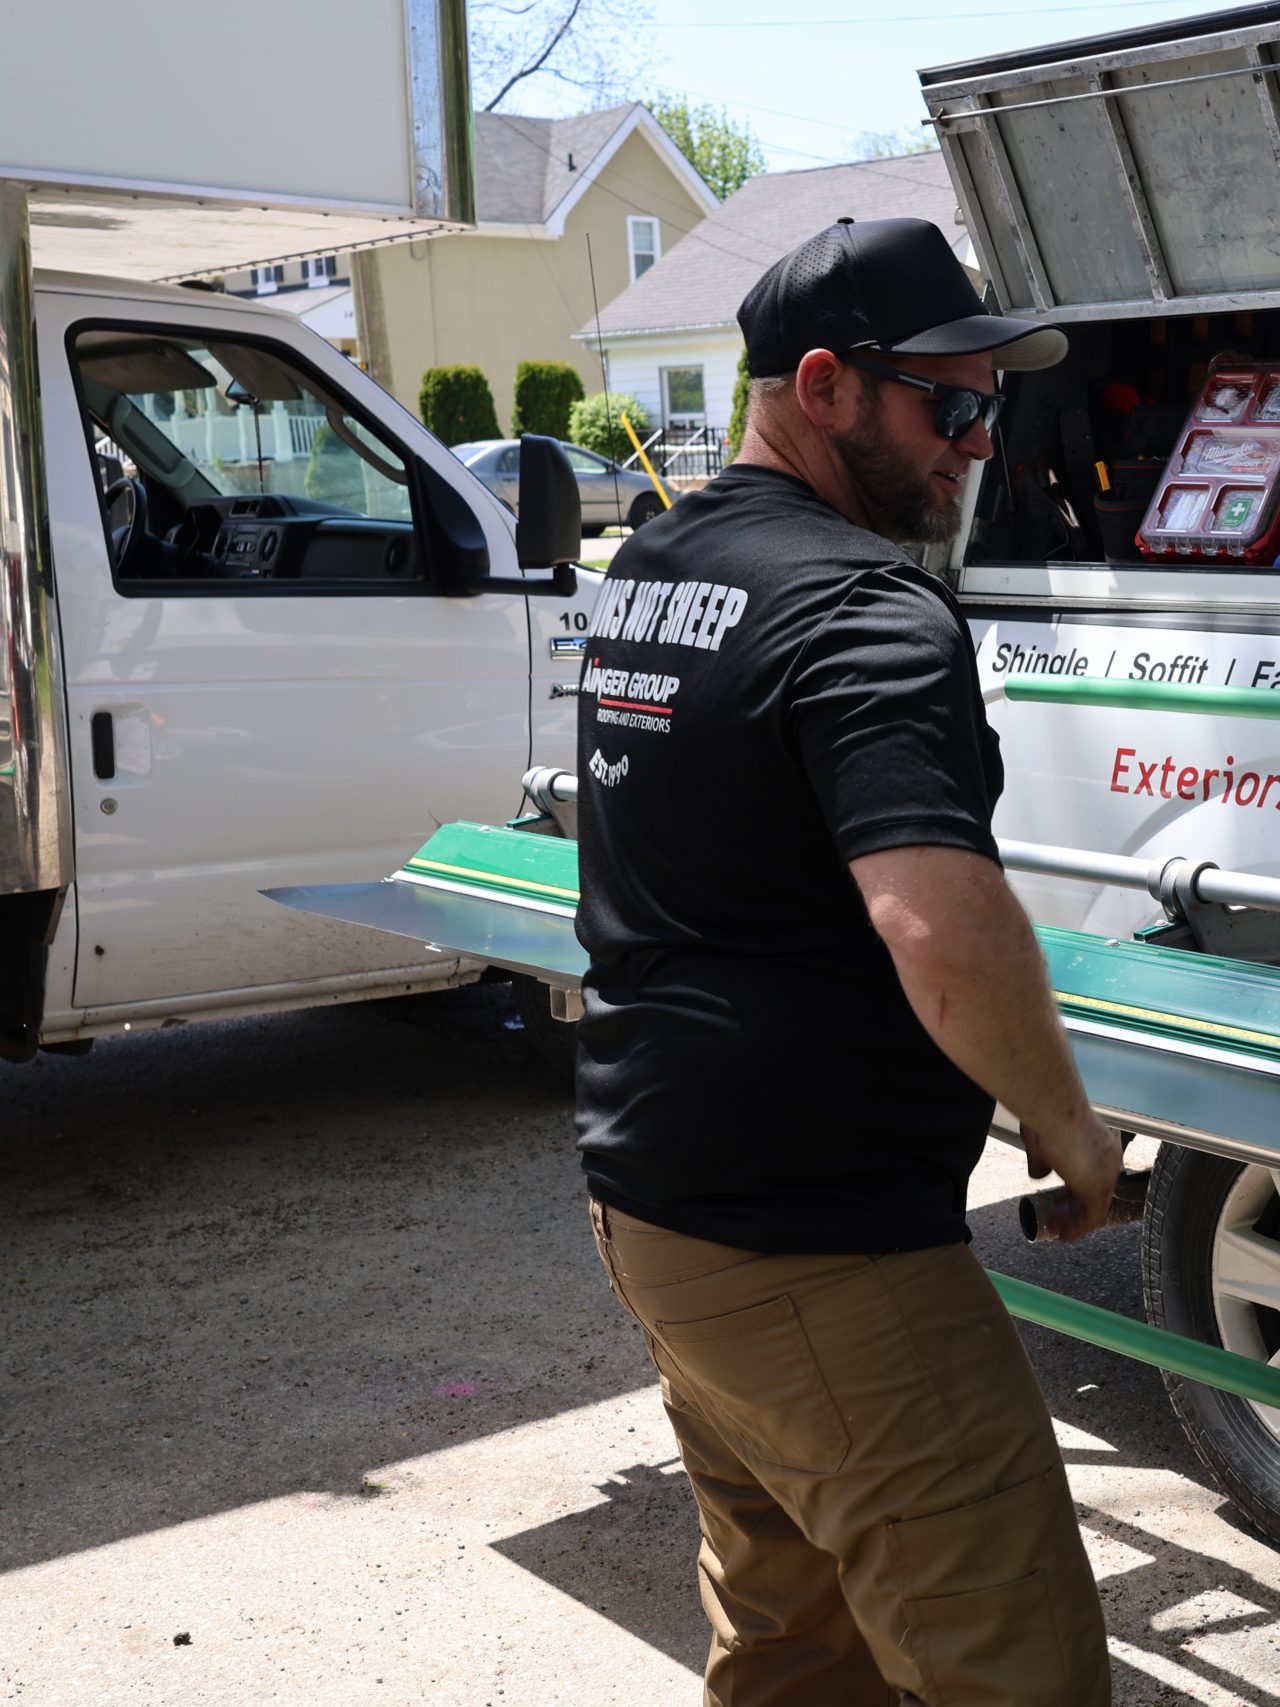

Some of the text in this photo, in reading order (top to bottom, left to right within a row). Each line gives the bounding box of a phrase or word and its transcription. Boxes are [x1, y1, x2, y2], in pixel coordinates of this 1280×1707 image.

[559, 612, 589, 631] 10
[621, 581, 674, 643] NOT
[658, 582, 748, 651] SHEEP
[992, 642, 1089, 677] Shingle
[1129, 652, 1208, 683] Soffit
[627, 671, 680, 703] GROUP
[597, 708, 671, 734] ROOFING AND EXTERIORS
